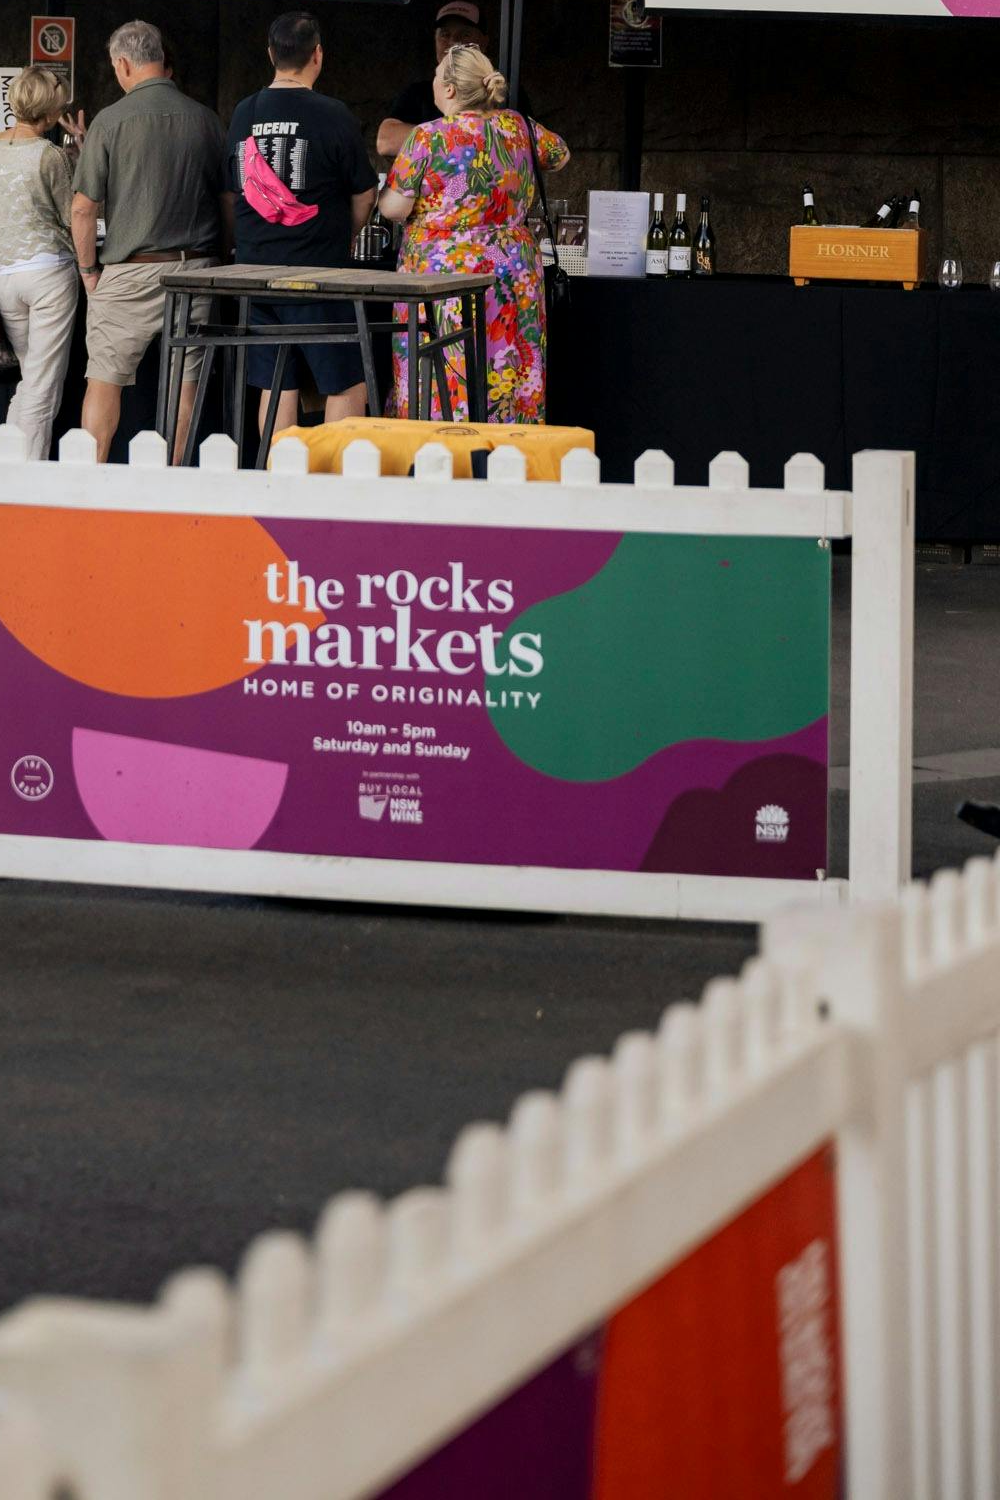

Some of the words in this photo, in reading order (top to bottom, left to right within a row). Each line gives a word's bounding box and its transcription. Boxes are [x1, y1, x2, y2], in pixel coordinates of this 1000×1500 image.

[816, 243, 890, 259] HORNER
[264, 560, 345, 613] the
[356, 561, 514, 613] rocks
[243, 605, 545, 678] markets
[243, 678, 315, 698] HOME
[326, 682, 360, 700] OF
[371, 684, 542, 710] ORIGINALITY
[347, 720, 387, 736] 10am
[402, 723, 437, 740] 5pm
[312, 736, 379, 756] Saturday
[382, 740, 411, 756] and
[414, 742, 471, 761] Sunday
[358, 783, 382, 794] BUY
[385, 784, 424, 797] LOCAL
[389, 798, 420, 811] NSW
[389, 810, 424, 824] WINE
[755, 824, 789, 837] NSW
